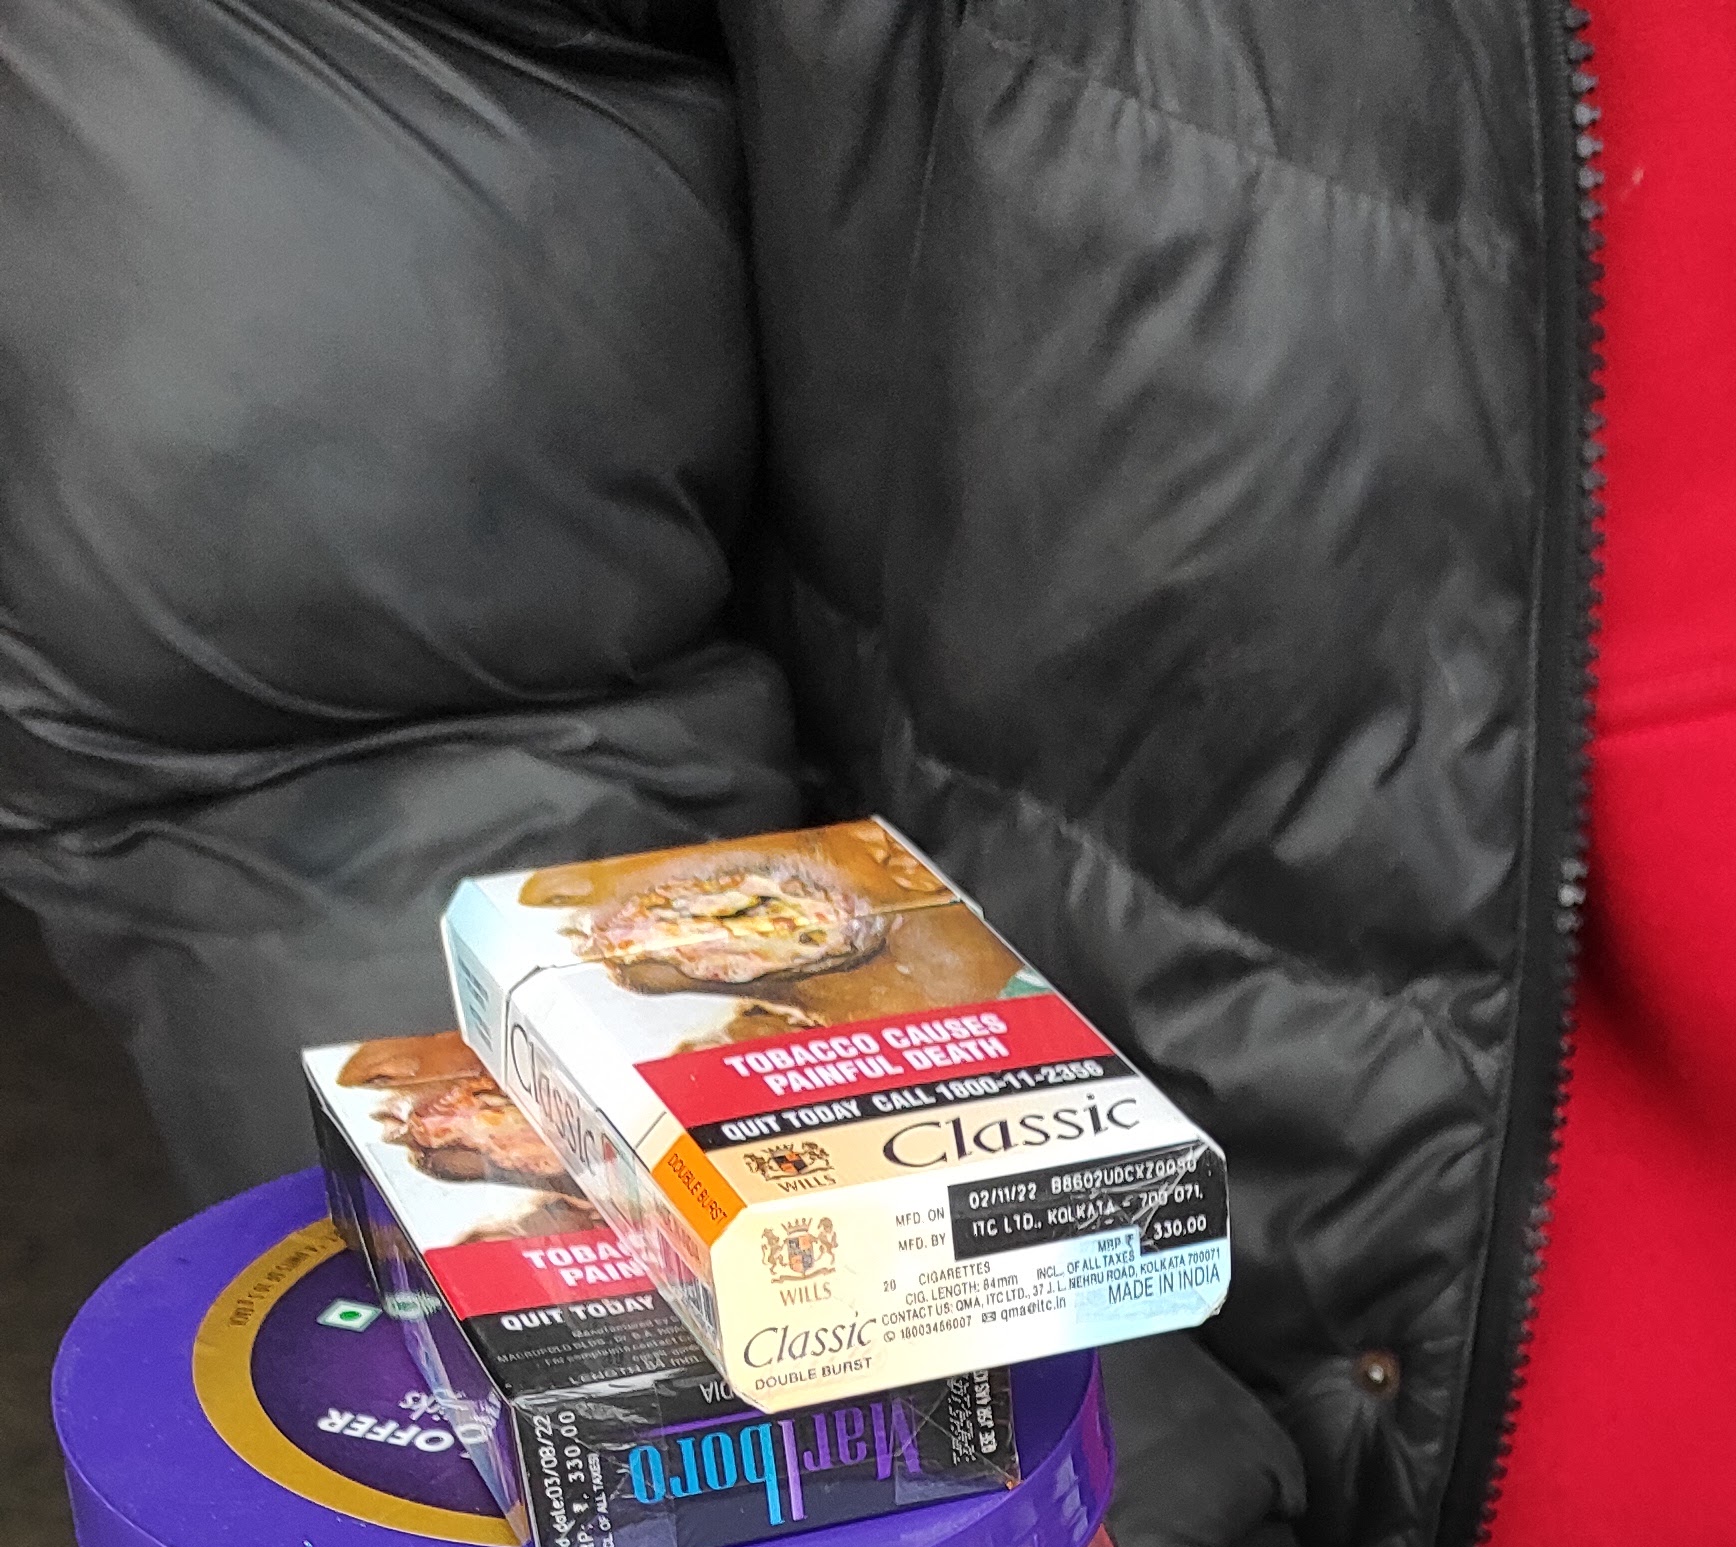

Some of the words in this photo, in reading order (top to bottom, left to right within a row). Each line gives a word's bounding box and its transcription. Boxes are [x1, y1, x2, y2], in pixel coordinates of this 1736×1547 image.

[723, 1031, 880, 1077] TOBACCO
[883, 1012, 1008, 1050] CAUSES
[763, 1055, 903, 1097] PAINFUL
[907, 1037, 1010, 1072] DEATH
[510, 1023, 595, 1176] Classic
[721, 1118, 781, 1142] QUIT
[784, 1101, 862, 1128] TODAY
[872, 1089, 937, 1113] CALL
[883, 1092, 1140, 1168] Classic
[668, 1153, 702, 1203] DOUBLE
[700, 1195, 728, 1225] BURST
[777, 1173, 837, 1192] WILLS
[895, 1211, 925, 1227] MFD.
[928, 1207, 945, 1221] ON
[972, 1221, 998, 1237] ITC
[1048, 1200, 1115, 1226] KOLKATA
[1098, 1236, 1122, 1252] MRP
[1153, 1215, 1207, 1240] 330.00
[899, 1236, 928, 1251] MFD.
[931, 1232, 946, 1246] BY
[918, 1262, 991, 1286] CIGARETTES
[1082, 1256, 1102, 1271] ALL
[1103, 1250, 1135, 1268] TAXES
[1109, 1281, 1154, 1305] MADE
[1158, 1275, 1173, 1293] IN
[1177, 1263, 1220, 1291] INDIA
[779, 1282, 832, 1307] WILLS
[881, 1306, 933, 1325] CONTACT
[1140, 1256, 1186, 1278] KOLKATA
[905, 1291, 928, 1305] CIG.
[929, 1282, 980, 1301] LENGTH:
[500, 1308, 565, 1332] QUIT
[570, 1295, 654, 1320] TODAY
[743, 1311, 877, 1368] Classic
[755, 1368, 817, 1391] DOUBLE
[821, 1357, 872, 1380] BURST
[316, 1406, 454, 1454] OFFER
[629, 1394, 922, 1526] Marlboro
